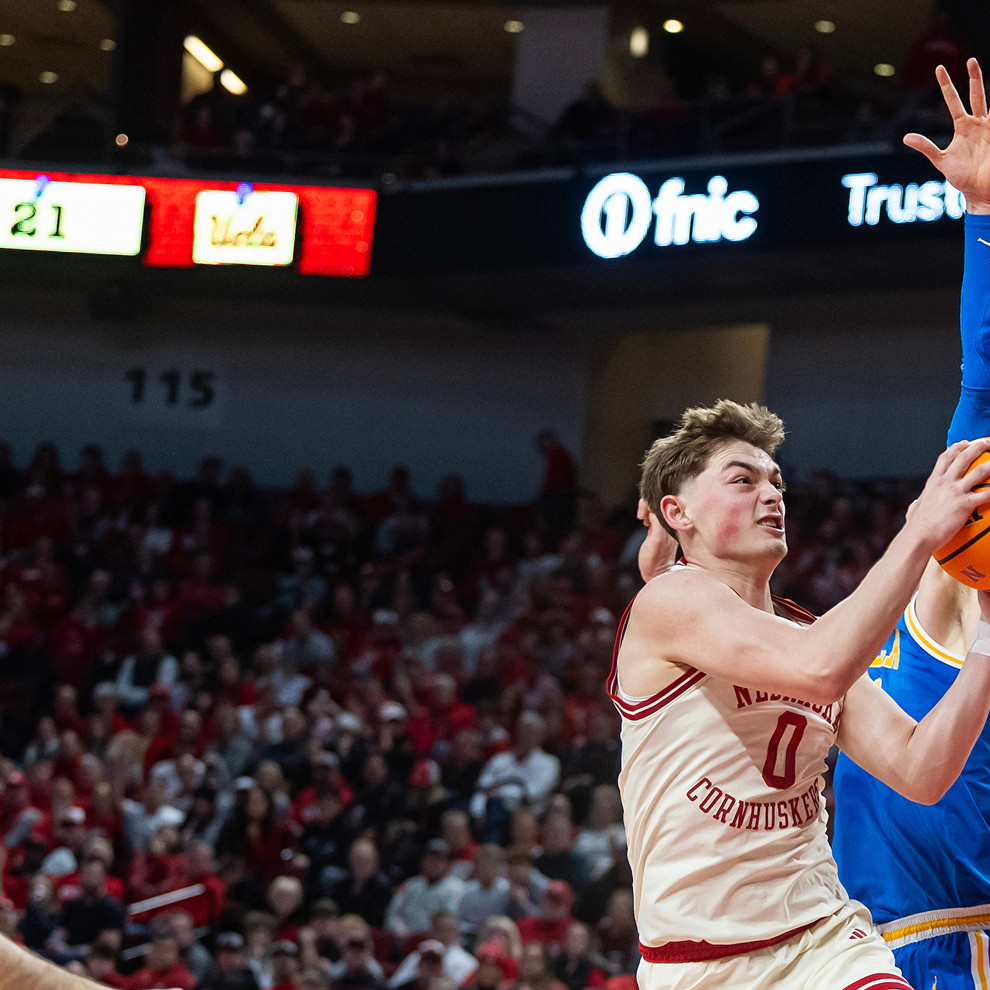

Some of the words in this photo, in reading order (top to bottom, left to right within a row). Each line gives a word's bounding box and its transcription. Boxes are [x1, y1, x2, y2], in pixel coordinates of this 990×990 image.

[10, 203, 65, 239] 21
[652, 175, 760, 247] fnic
[124, 366, 215, 407] 115
[762, 710, 808, 790] 0
